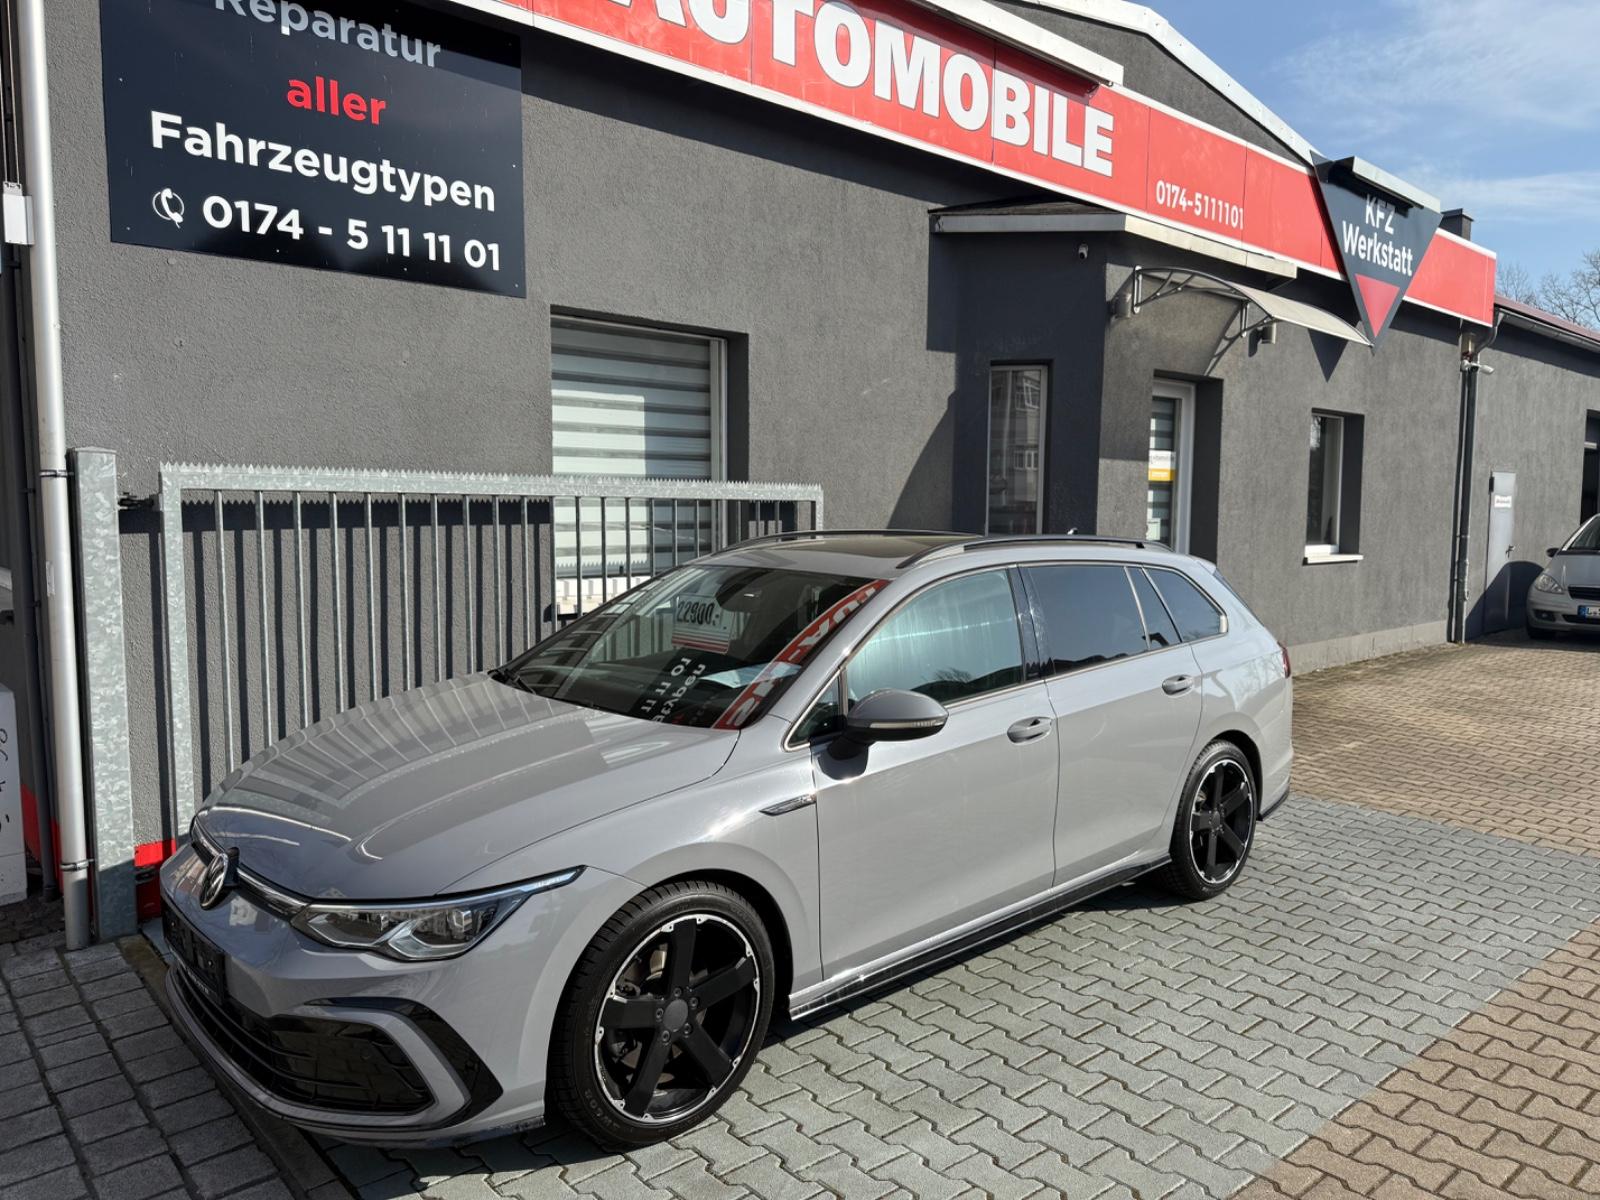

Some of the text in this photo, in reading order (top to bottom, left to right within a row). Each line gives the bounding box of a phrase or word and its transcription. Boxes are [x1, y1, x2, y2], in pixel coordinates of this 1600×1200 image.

[287, 76, 387, 125] aller
[151, 110, 496, 212] Fahrzeugtypen
[1156, 180, 1244, 230] 0174-5111101
[1365, 194, 1395, 235] KFZ
[203, 195, 304, 240] 0174
[347, 218, 369, 250] 5
[381, 225, 410, 257] 11
[424, 232, 451, 264] 11
[464, 239, 500, 271] 01
[1342, 220, 1413, 276] Werkstatt
